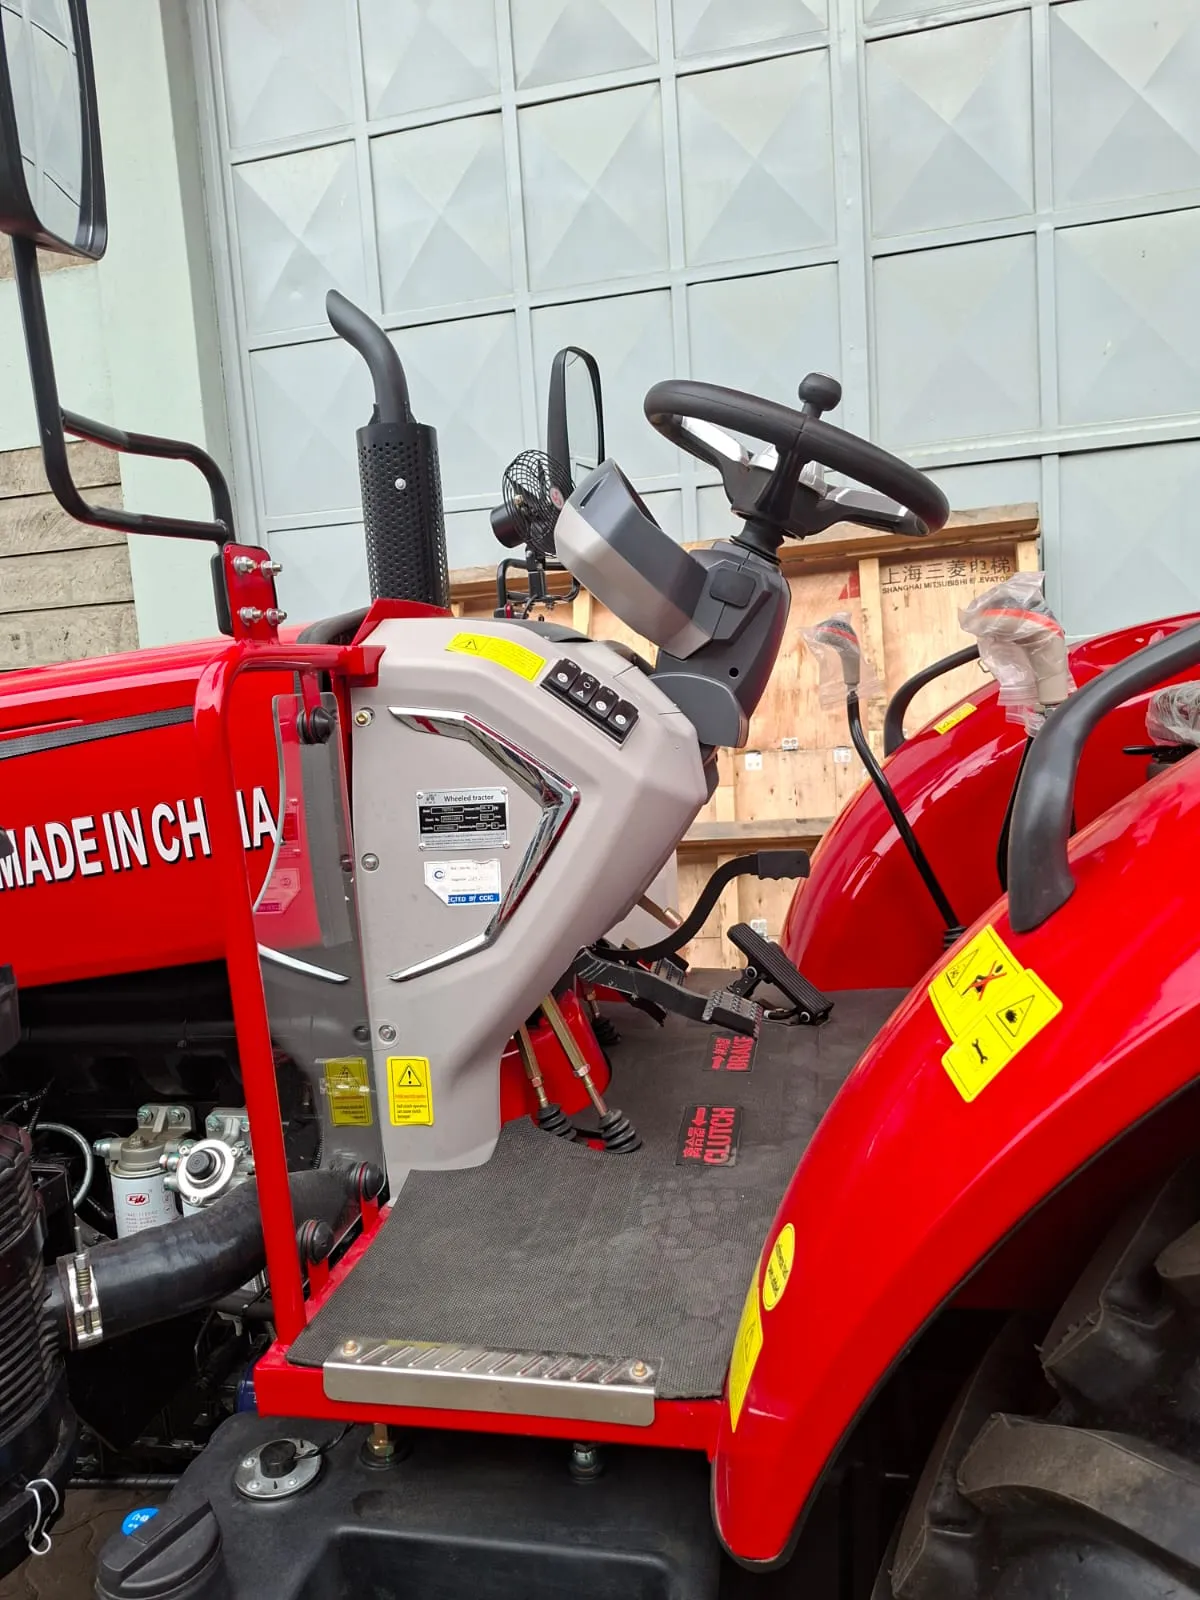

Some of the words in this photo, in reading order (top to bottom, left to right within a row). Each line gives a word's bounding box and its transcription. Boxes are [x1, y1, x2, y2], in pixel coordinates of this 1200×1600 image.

[882, 584, 922, 594] SHANGHAI
[923, 577, 968, 588] MITSUBISHI
[443, 794, 472, 802] Wheeled
[102, 807, 149, 870] IN
[726, 1036, 754, 1070] BRAKE
[703, 1107, 736, 1164] CLUTCH
